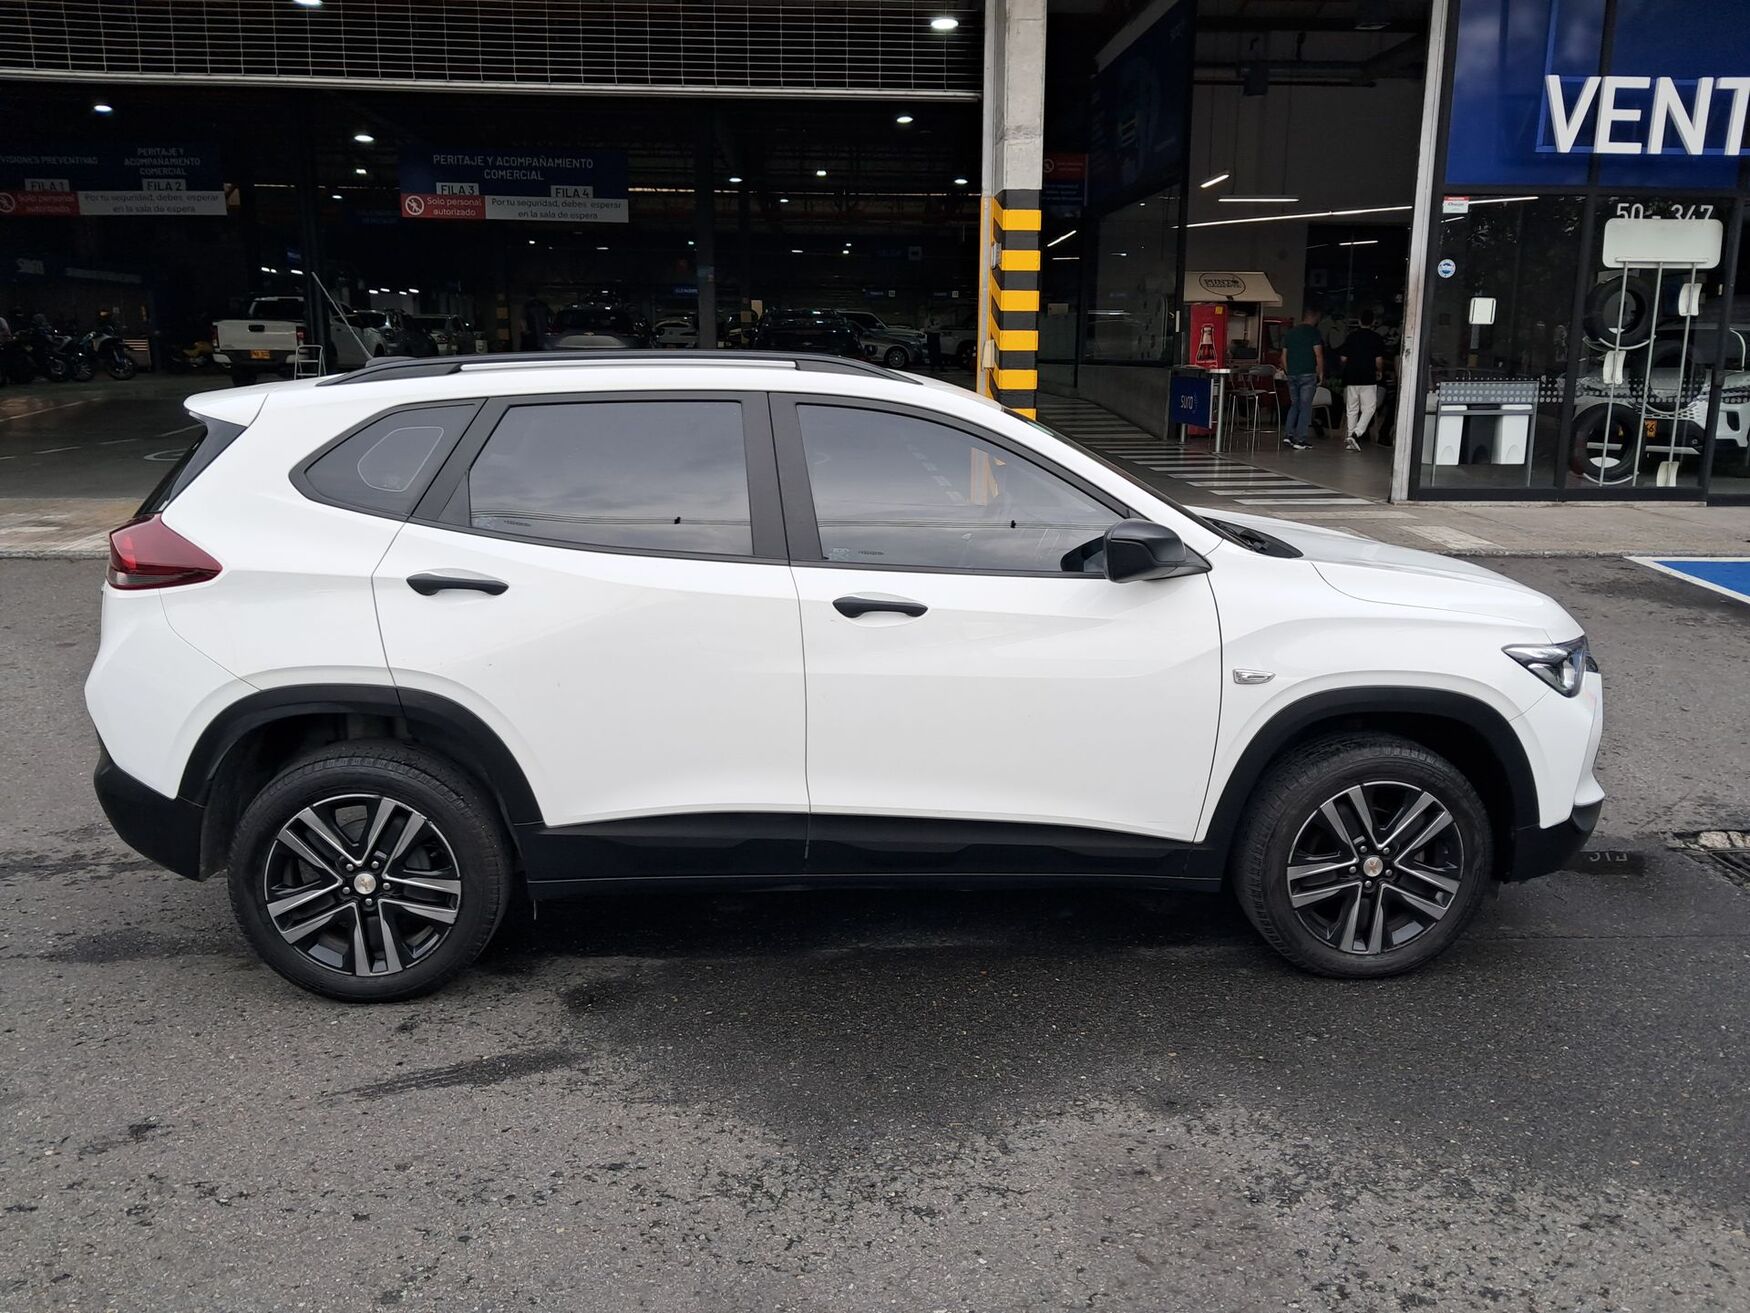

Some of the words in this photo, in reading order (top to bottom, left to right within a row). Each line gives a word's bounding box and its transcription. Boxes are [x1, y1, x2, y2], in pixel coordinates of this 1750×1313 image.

[1545, 74, 1750, 156] VENT
[433, 154, 485, 165] PERITAJE
[487, 155, 495, 166] Y
[495, 154, 594, 168] ACOMPAÑAMIENTO
[484, 169, 545, 181] COMERCIAL
[147, 181, 172, 191] FILA
[175, 181, 182, 191] 2
[441, 184, 466, 195] FILA
[468, 185, 475, 195] 3
[555, 187, 579, 198] FILA
[582, 188, 589, 198] 4
[427, 197, 445, 205] Solo
[446, 197, 483, 208] personal
[433, 208, 477, 217] autorizado
[540, 210, 556, 218] sala
[557, 211, 569, 219] de
[570, 212, 598, 220] espera
